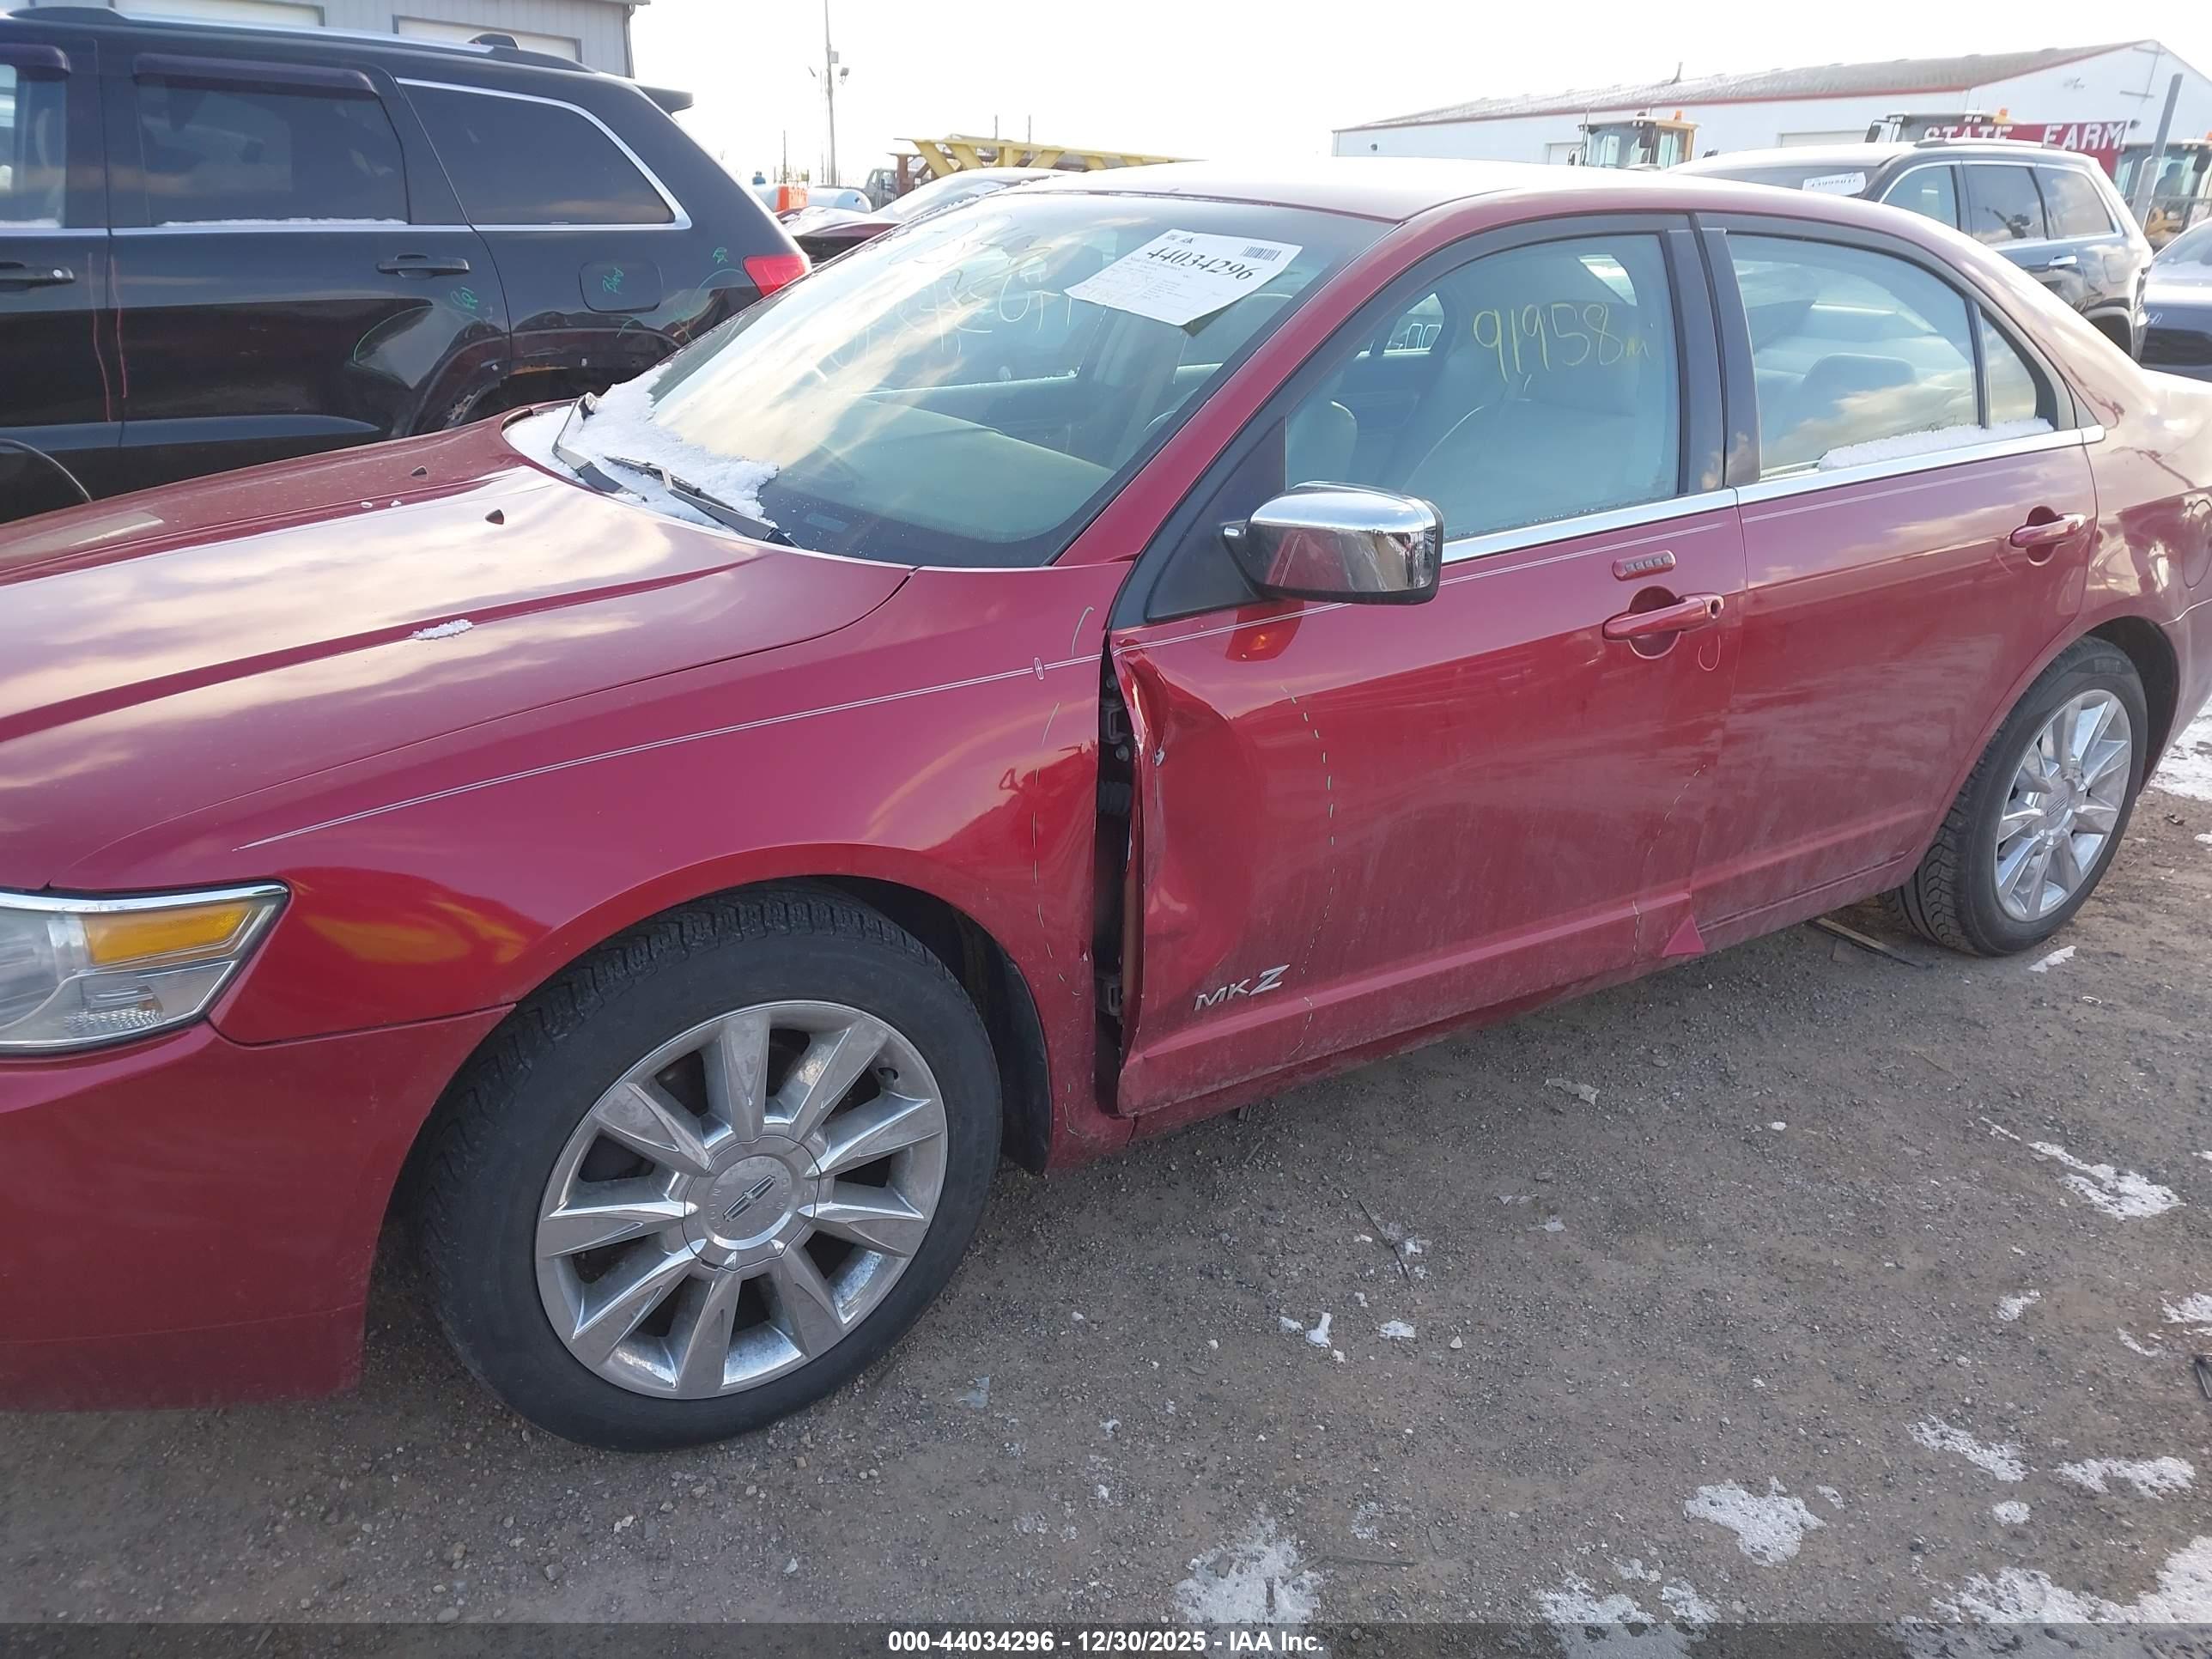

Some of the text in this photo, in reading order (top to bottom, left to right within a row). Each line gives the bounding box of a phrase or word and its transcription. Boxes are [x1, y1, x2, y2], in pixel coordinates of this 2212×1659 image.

[2040, 123, 2127, 151] FARM
[1146, 246, 1262, 280] 44034296
[1194, 963, 1291, 1011] MKZ
